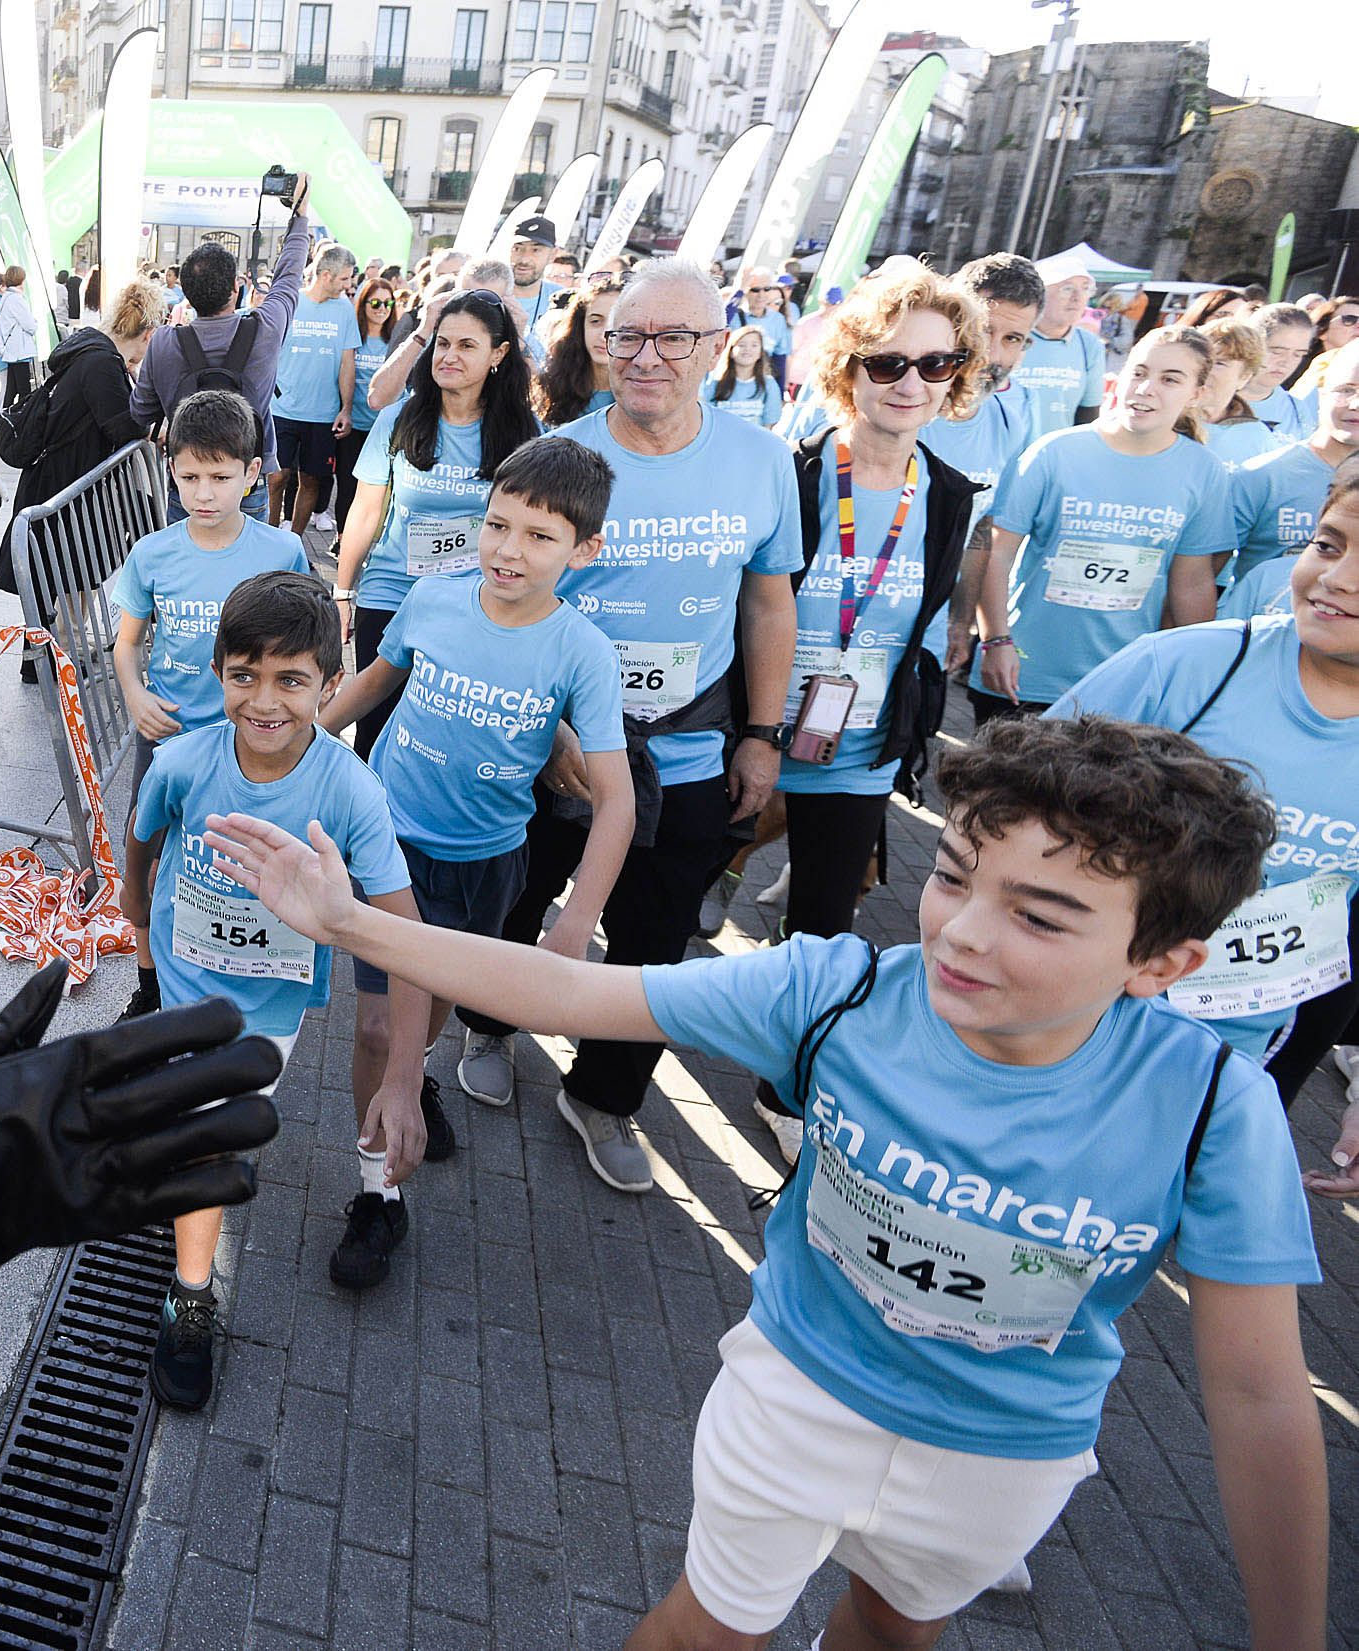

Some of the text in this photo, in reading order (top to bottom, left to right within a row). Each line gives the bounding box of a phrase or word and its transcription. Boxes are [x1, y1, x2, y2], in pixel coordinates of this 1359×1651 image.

[629, 510, 747, 539] marcha
[1062, 497, 1186, 528] En marcha
[1278, 508, 1312, 526] En
[431, 534, 466, 554] 356
[618, 559, 648, 567] cancro
[1084, 563, 1129, 583] 672
[601, 606, 646, 615] Pontevedra
[602, 599, 647, 609] Deputación
[413, 650, 555, 716] En marcha
[427, 704, 452, 721] cancro
[411, 743, 446, 766] Pontevedra
[412, 738, 447, 760] Deputación
[179, 877, 226, 905] Pontevedra
[204, 876, 232, 893] cancro
[178, 894, 258, 924] pola investigación
[179, 887, 221, 911] en marcha
[210, 921, 269, 949] 154
[1225, 926, 1306, 965] 152
[812, 1082, 1159, 1253] En marcha
[820, 1162, 843, 1196] pola
[845, 1194, 967, 1262] investigación
[866, 1233, 986, 1304] 142
